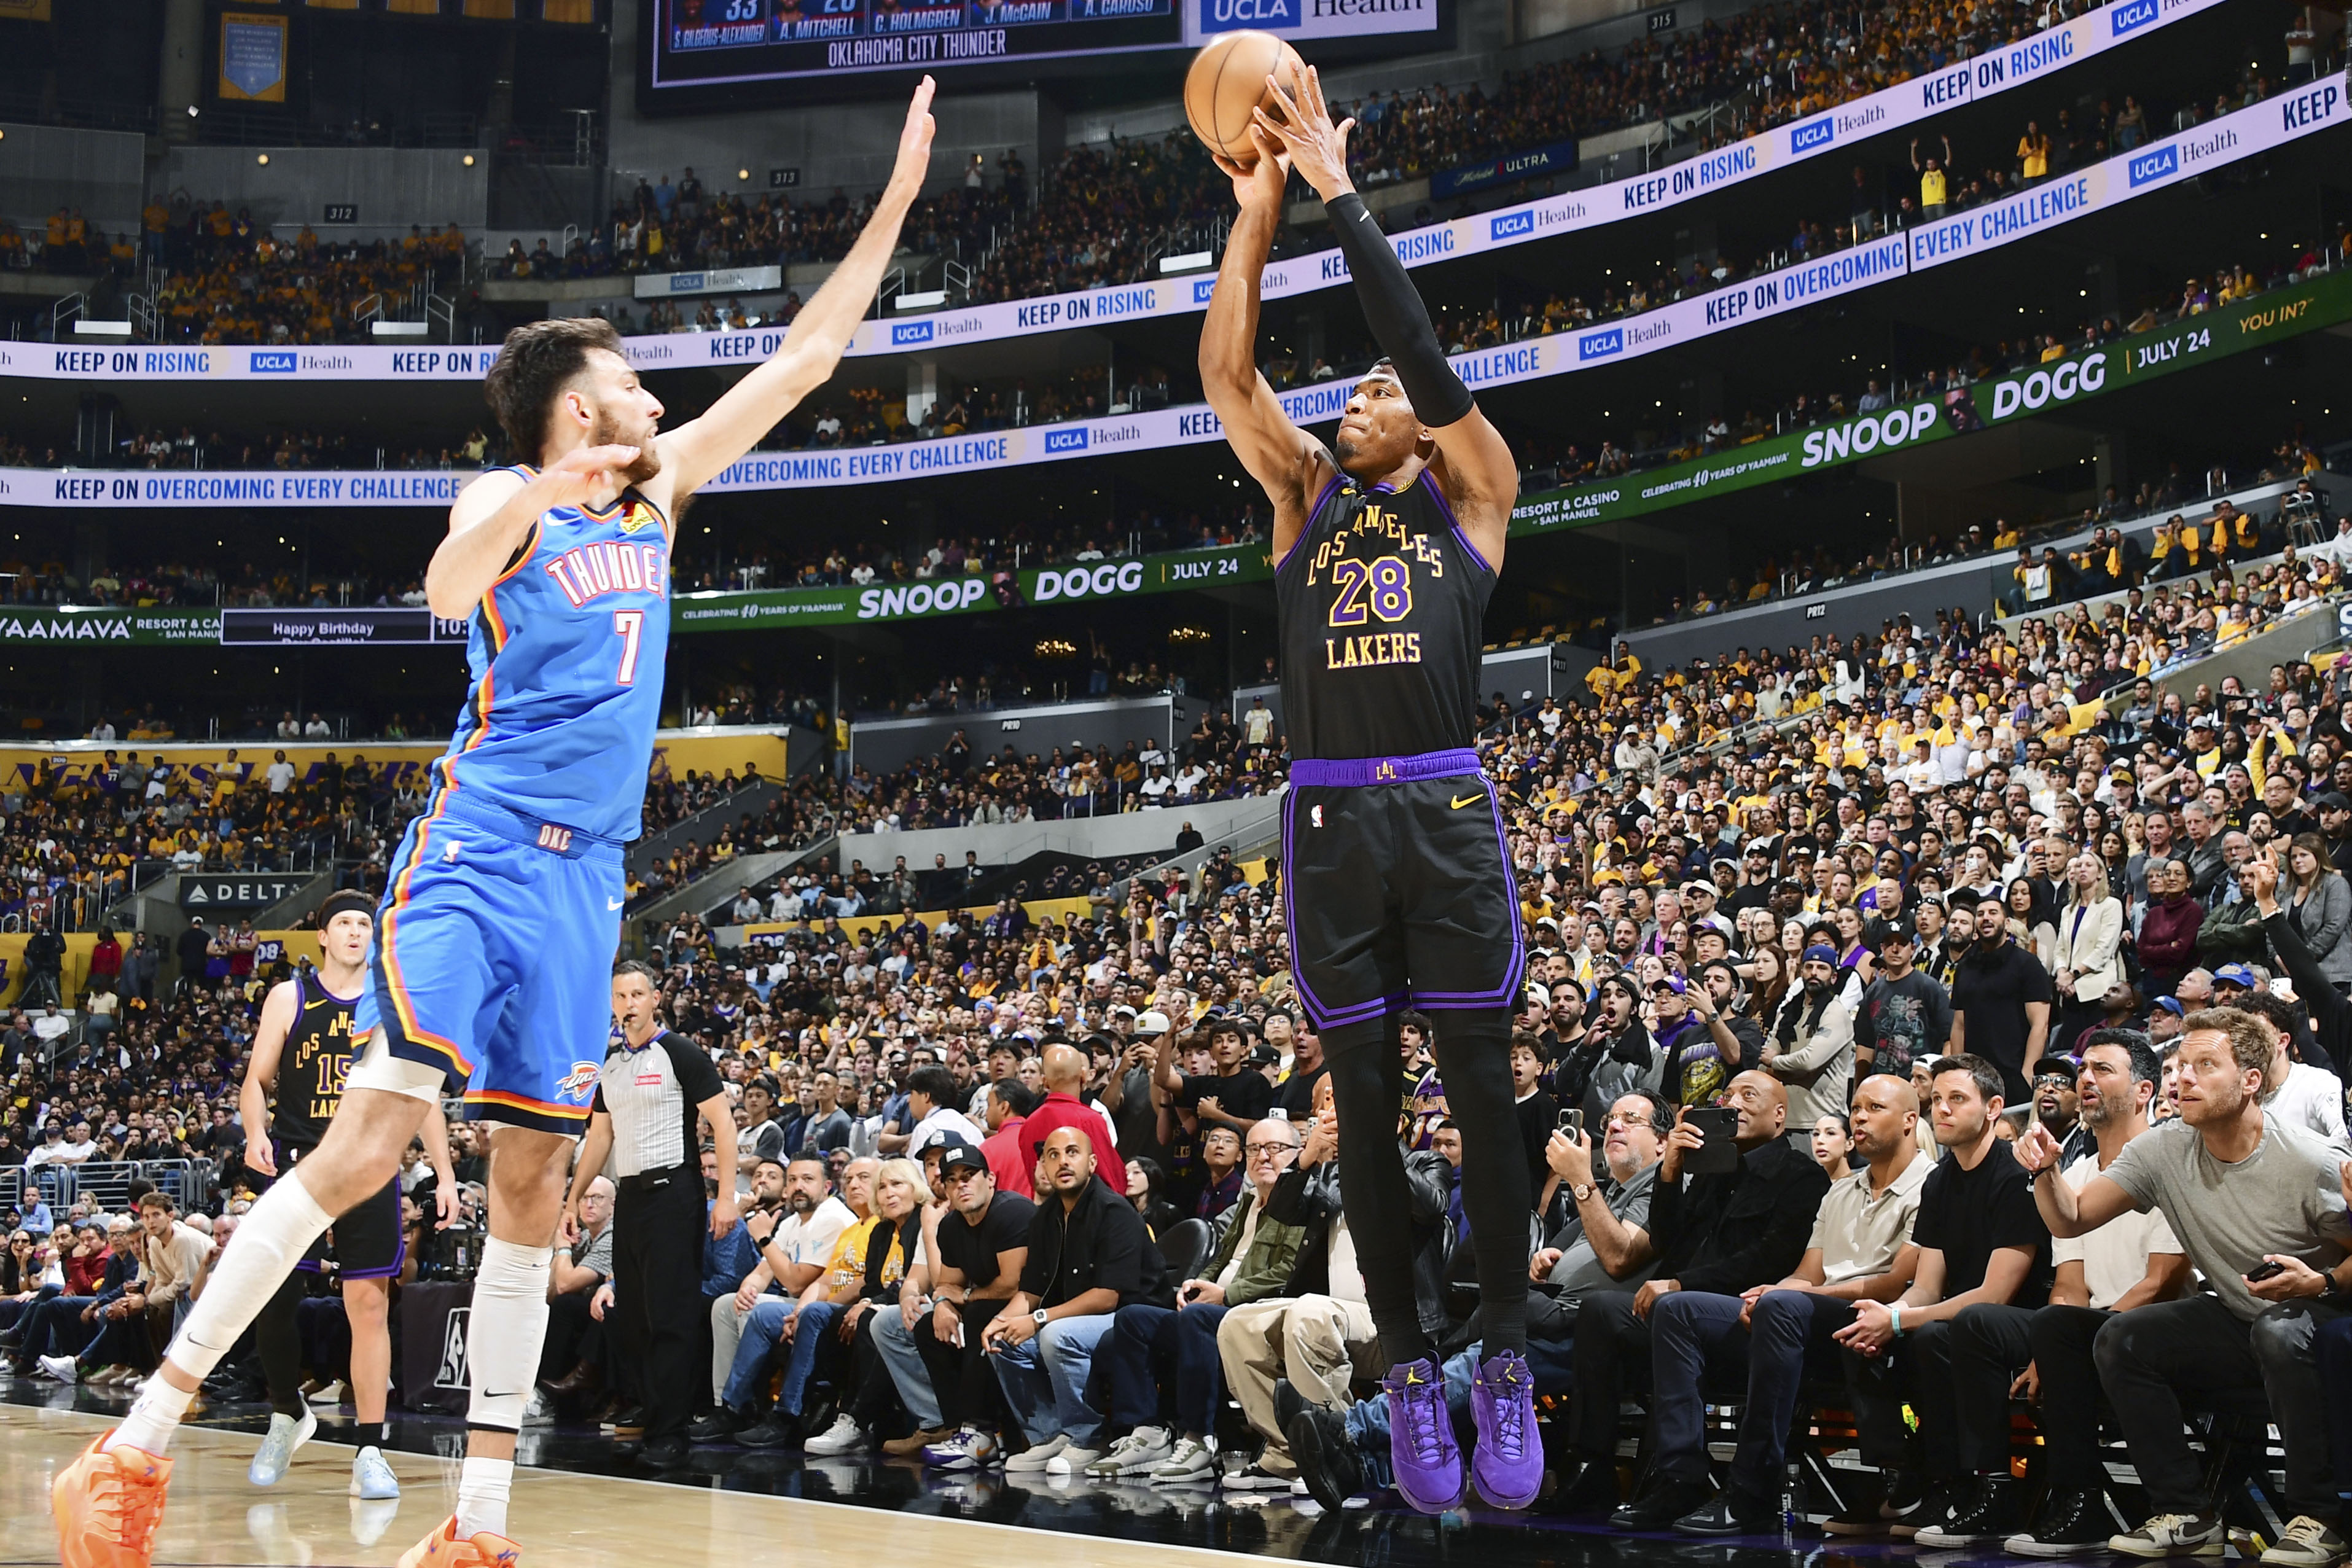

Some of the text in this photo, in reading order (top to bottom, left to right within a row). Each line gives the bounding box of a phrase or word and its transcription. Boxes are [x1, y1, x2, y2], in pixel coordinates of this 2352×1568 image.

[875, 9, 961, 33] C. HOLMGREN
[984, 2, 1052, 25] J. McCAIN
[1085, 0, 1154, 17] A. CARUSO
[1214, 0, 1289, 22] UCLA
[1652, 14, 1671, 28] 315
[2117, 2, 2153, 28] UCLA
[683, 24, 765, 47] GILGEOUS-ALEXANDER
[779, 17, 855, 40] A. MITCHELL
[828, 28, 1006, 68] OKLAHOMA CITY THUNDER
[1923, 30, 2073, 108] KEEP ON RISING
[2283, 86, 2338, 131] KEEP
[1795, 105, 1886, 147] UCLA Health
[1506, 152, 1549, 173] ULTRA
[2135, 129, 2238, 181] UCLA Health
[775, 173, 795, 184] 313
[1623, 146, 1756, 210] KEEP ON RISING
[330, 208, 352, 219] 312
[1495, 203, 1586, 235] UCLA Health
[1397, 229, 1454, 262] RISING
[1706, 177, 2088, 326] KEEP ON OVERCOMING EVERY CHALLENGE
[674, 271, 744, 289] UCLA Health
[1018, 289, 1156, 327] KEEP ON RISING
[2240, 298, 2307, 335] YOU IN?
[896, 318, 983, 341] UCLA Health
[1584, 321, 1671, 356] UCLA Health
[625, 345, 673, 361] Health
[711, 335, 756, 358] KEEP
[56, 351, 210, 373] KEEP ON RISING
[256, 354, 353, 370] UCLA Health
[393, 352, 440, 373] KEEP
[447, 352, 472, 373] ON
[1991, 327, 2212, 421] DOGG JULY 24
[1049, 425, 1141, 450] UCLA Health
[1800, 402, 1937, 469] SNOOP
[721, 437, 1008, 484] OVERCOMING EVERY CHALLENGE
[56, 477, 462, 501] KEEP ON OVERCOMING EVERY CHALLENGE
[1641, 478, 1692, 499] CELEBRATING
[1692, 469, 1709, 489] 40
[1709, 465, 1735, 482] YEARS
[1735, 462, 1748, 476] OF
[1512, 490, 1620, 520] RESORT & CASINO
[1539, 507, 1600, 526] SAN MANUEL
[543, 540, 666, 609] THUNDER
[1034, 558, 1239, 602] DOGG JULY 24
[858, 578, 986, 619] SNOOP
[1328, 556, 1413, 627] 28
[137, 618, 187, 631] RESORT
[190, 618, 198, 630] &
[682, 609, 738, 620] CELEBRATING
[741, 604, 759, 618] 40
[759, 606, 786, 615] YEARS
[787, 604, 800, 614] OF
[165, 630, 186, 639] SAN
[273, 622, 375, 638] Happy Birthday
[614, 609, 643, 685] 7
[1325, 633, 1422, 670] LAKERS
[1376, 760, 1397, 781] LAL
[538, 824, 572, 852] OKC
[295, 1032, 321, 1069] LOS
[316, 1053, 353, 1095] 15
[636, 1076, 662, 1085] Emirates
